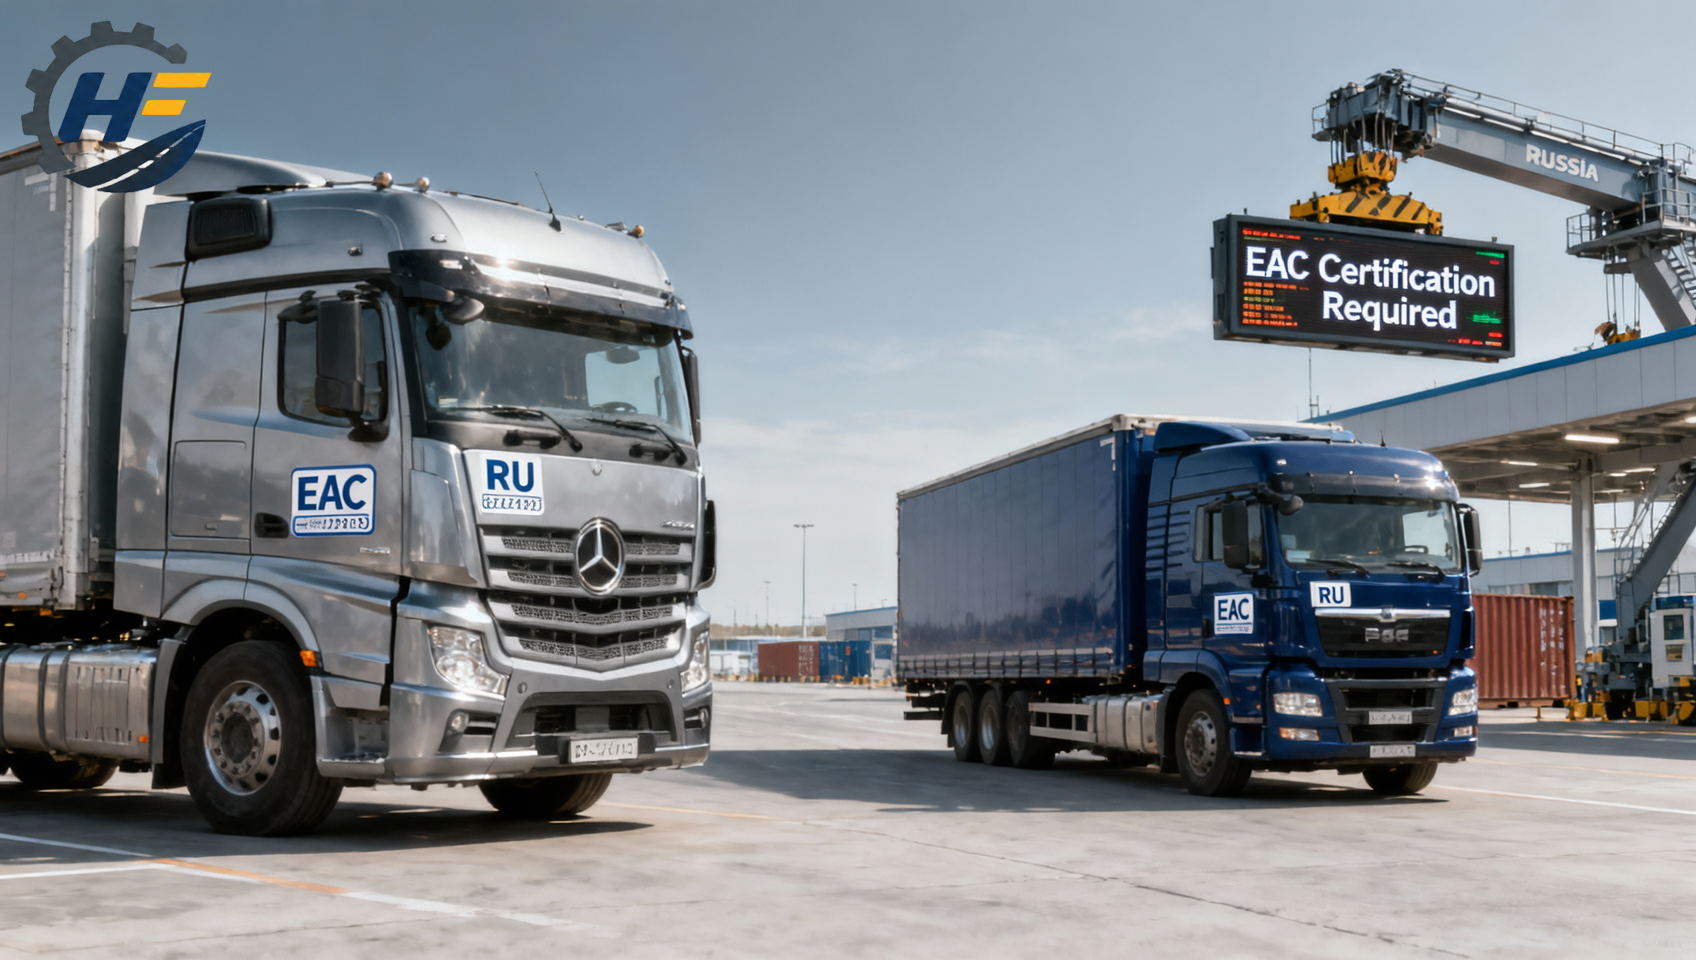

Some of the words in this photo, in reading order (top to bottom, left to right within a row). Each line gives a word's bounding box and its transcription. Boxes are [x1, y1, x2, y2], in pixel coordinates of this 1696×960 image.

[1245, 246, 1310, 280] EAC
[1318, 253, 1496, 298] Certification
[1322, 290, 1458, 331] Required
[297, 474, 368, 511] EAC
[486, 459, 535, 493] RU
[1217, 598, 1250, 621] EAC
[1318, 586, 1345, 605] RU
